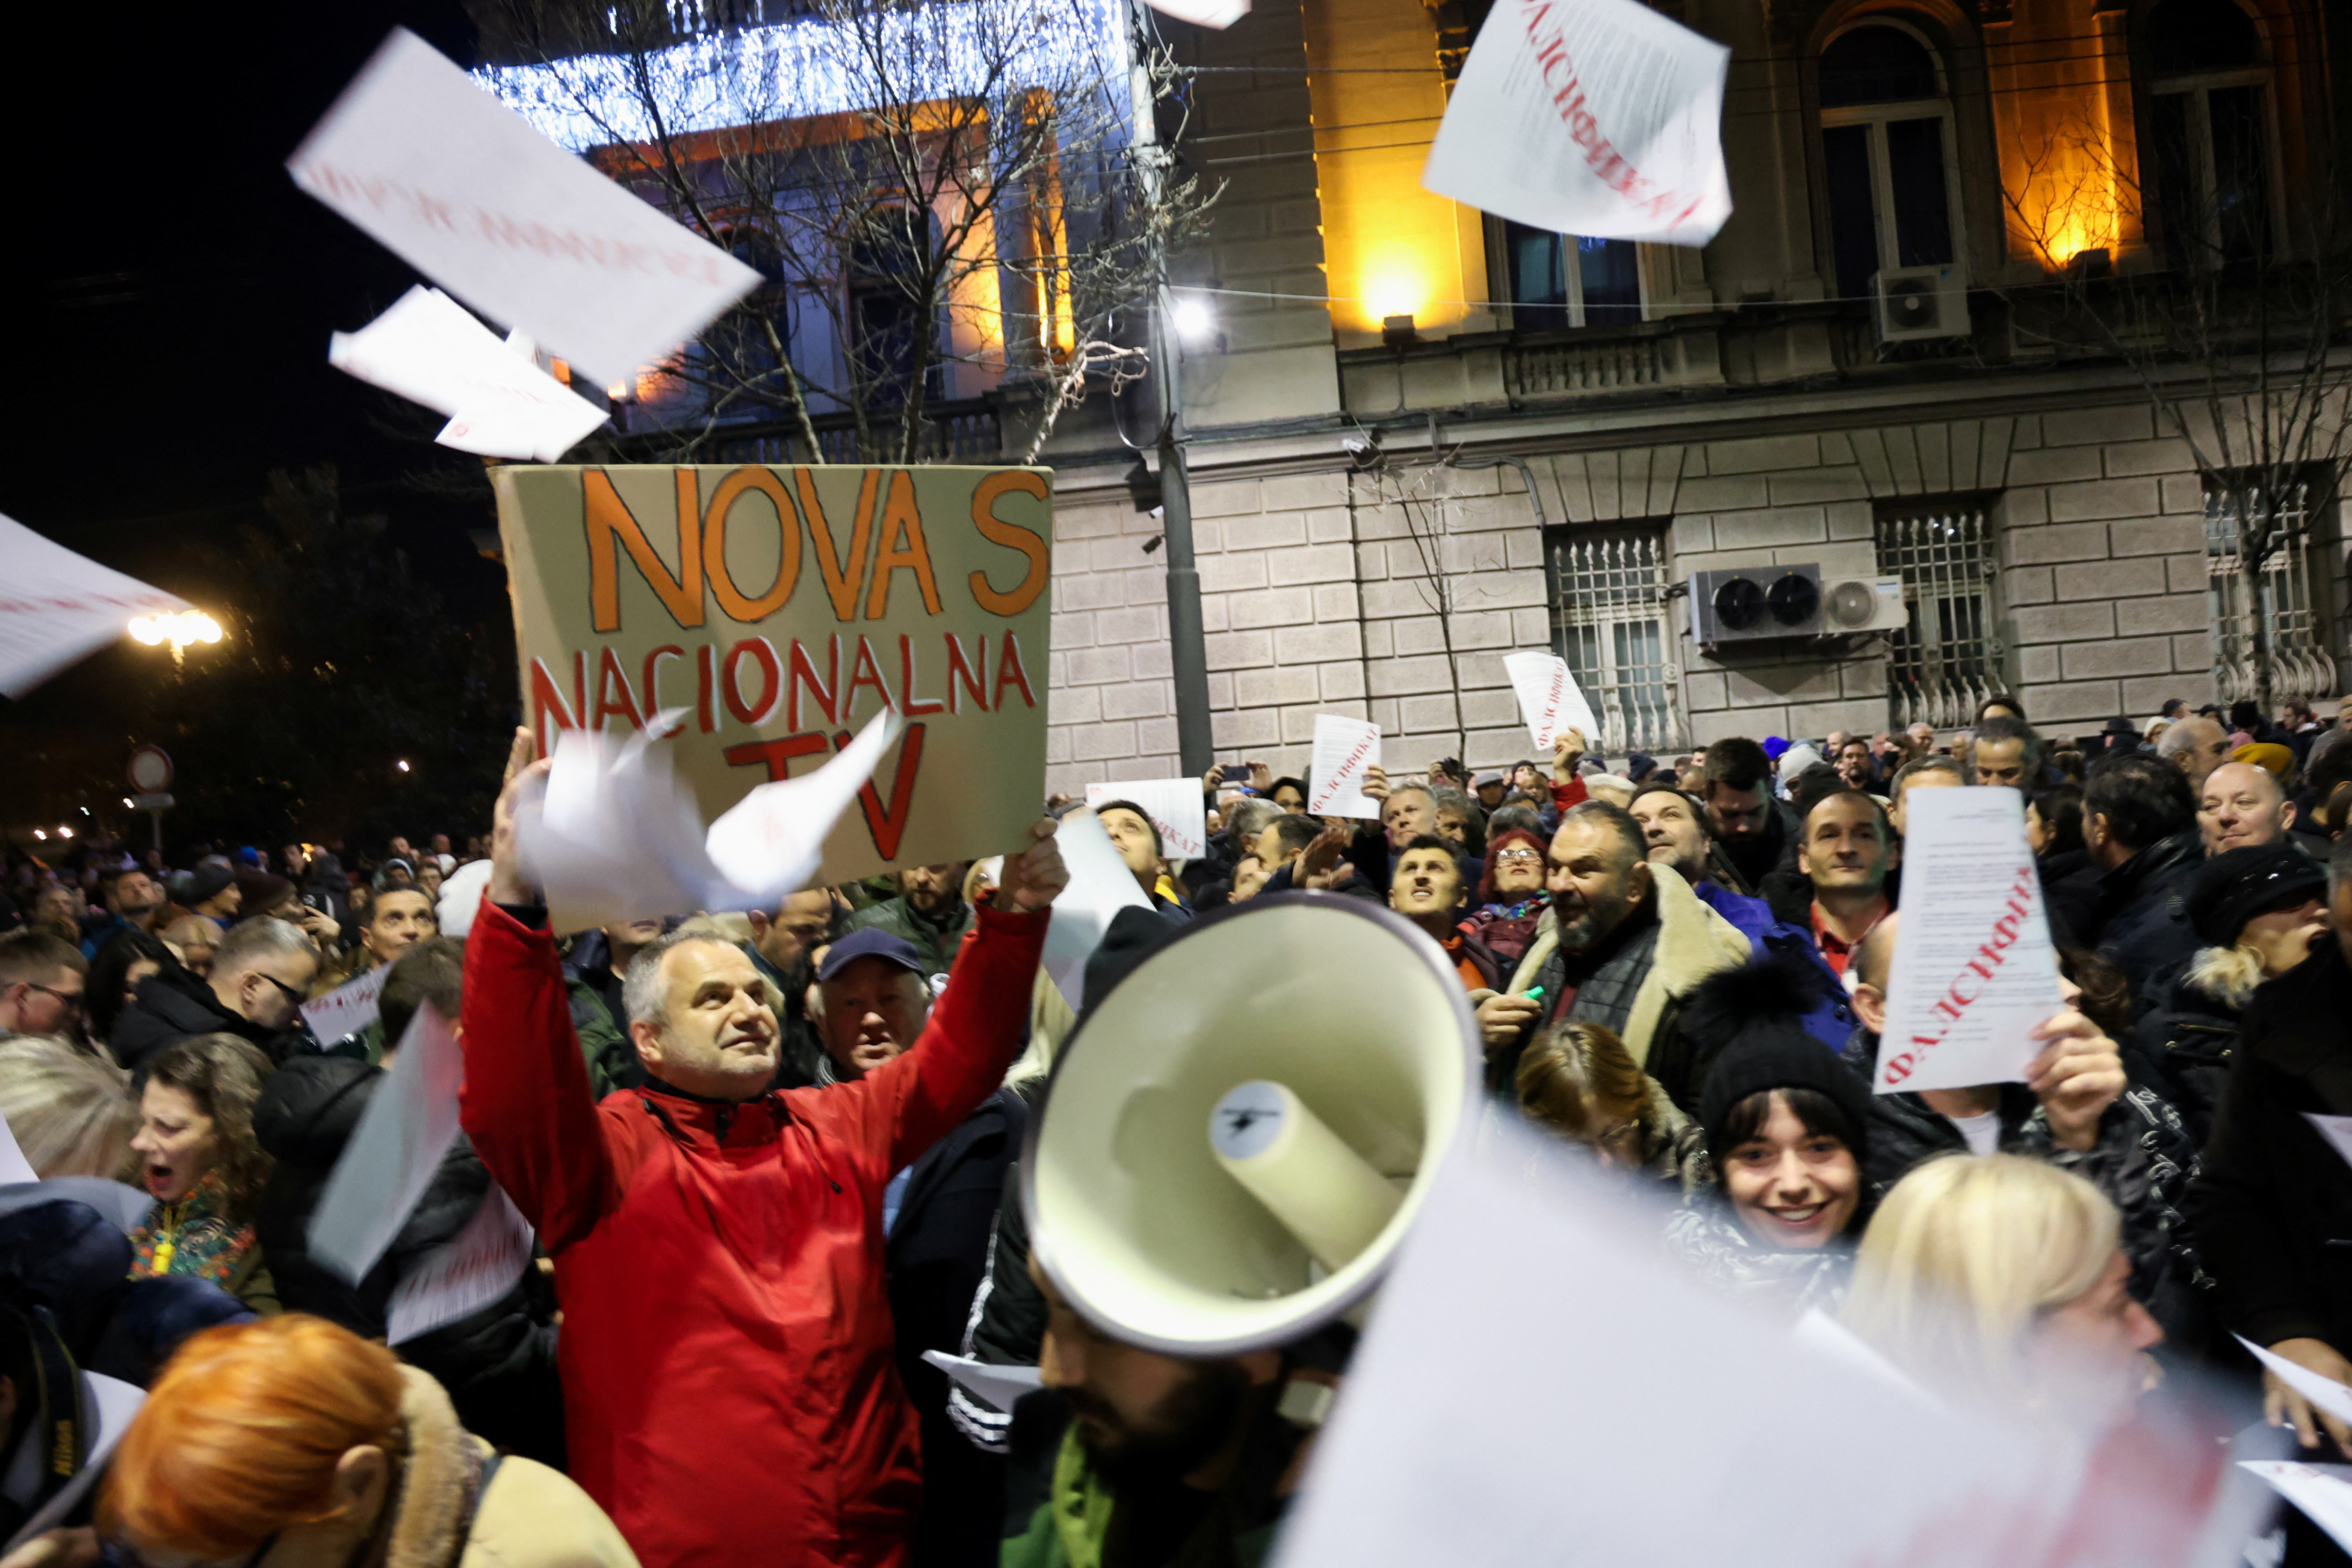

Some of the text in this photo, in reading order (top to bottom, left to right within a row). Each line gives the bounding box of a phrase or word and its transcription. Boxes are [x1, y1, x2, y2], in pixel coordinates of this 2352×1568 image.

[1521, 0, 1706, 230] АЛСИФИКАТ
[581, 465, 1051, 634] NOVA S
[530, 628, 1037, 759] NACIONALNA
[1537, 659, 1564, 746] ФАЛСИФИКАТ
[723, 722, 926, 861] TV
[1312, 726, 1377, 812] ФАЛСИФИКАТ
